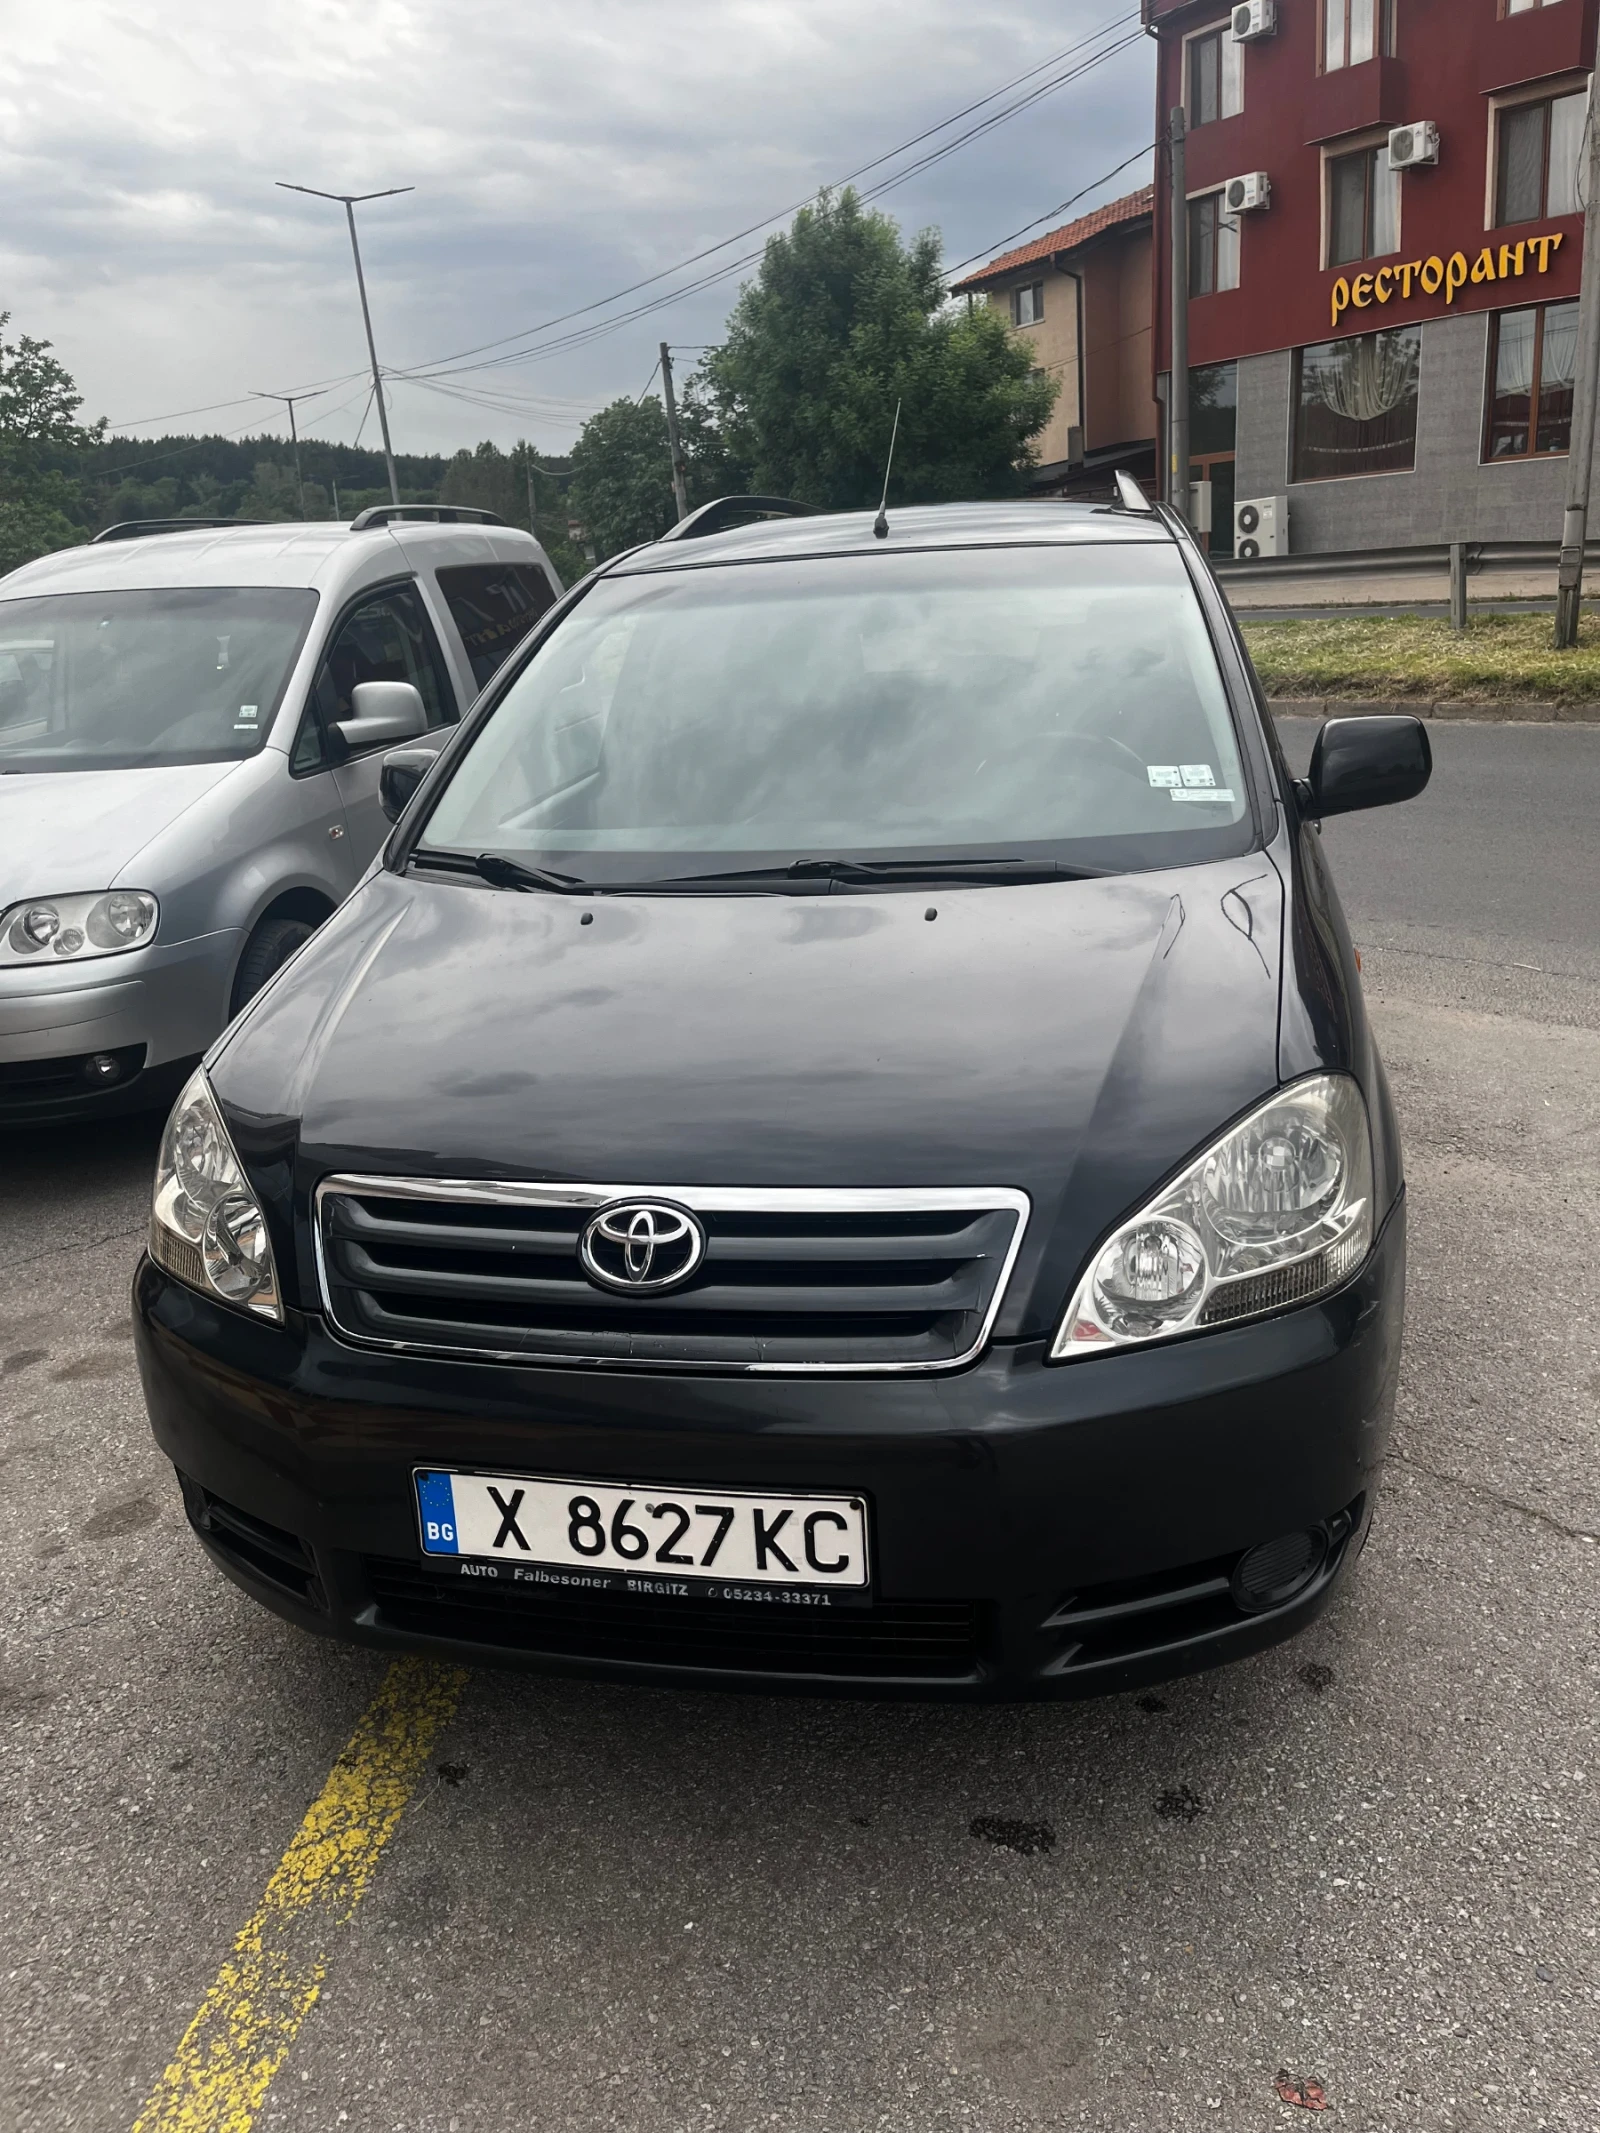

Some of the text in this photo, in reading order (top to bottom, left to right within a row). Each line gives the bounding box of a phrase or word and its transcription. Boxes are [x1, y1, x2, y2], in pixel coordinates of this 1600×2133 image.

[1331, 232, 1563, 327] РЕСТОРАНТ
[427, 1522, 453, 1541] BG
[486, 1486, 849, 1573] X 8627 KC
[460, 1563, 498, 1578] AUTO
[514, 1568, 611, 1589] Falbesoner
[723, 1587, 831, 1606] 05234-33371
